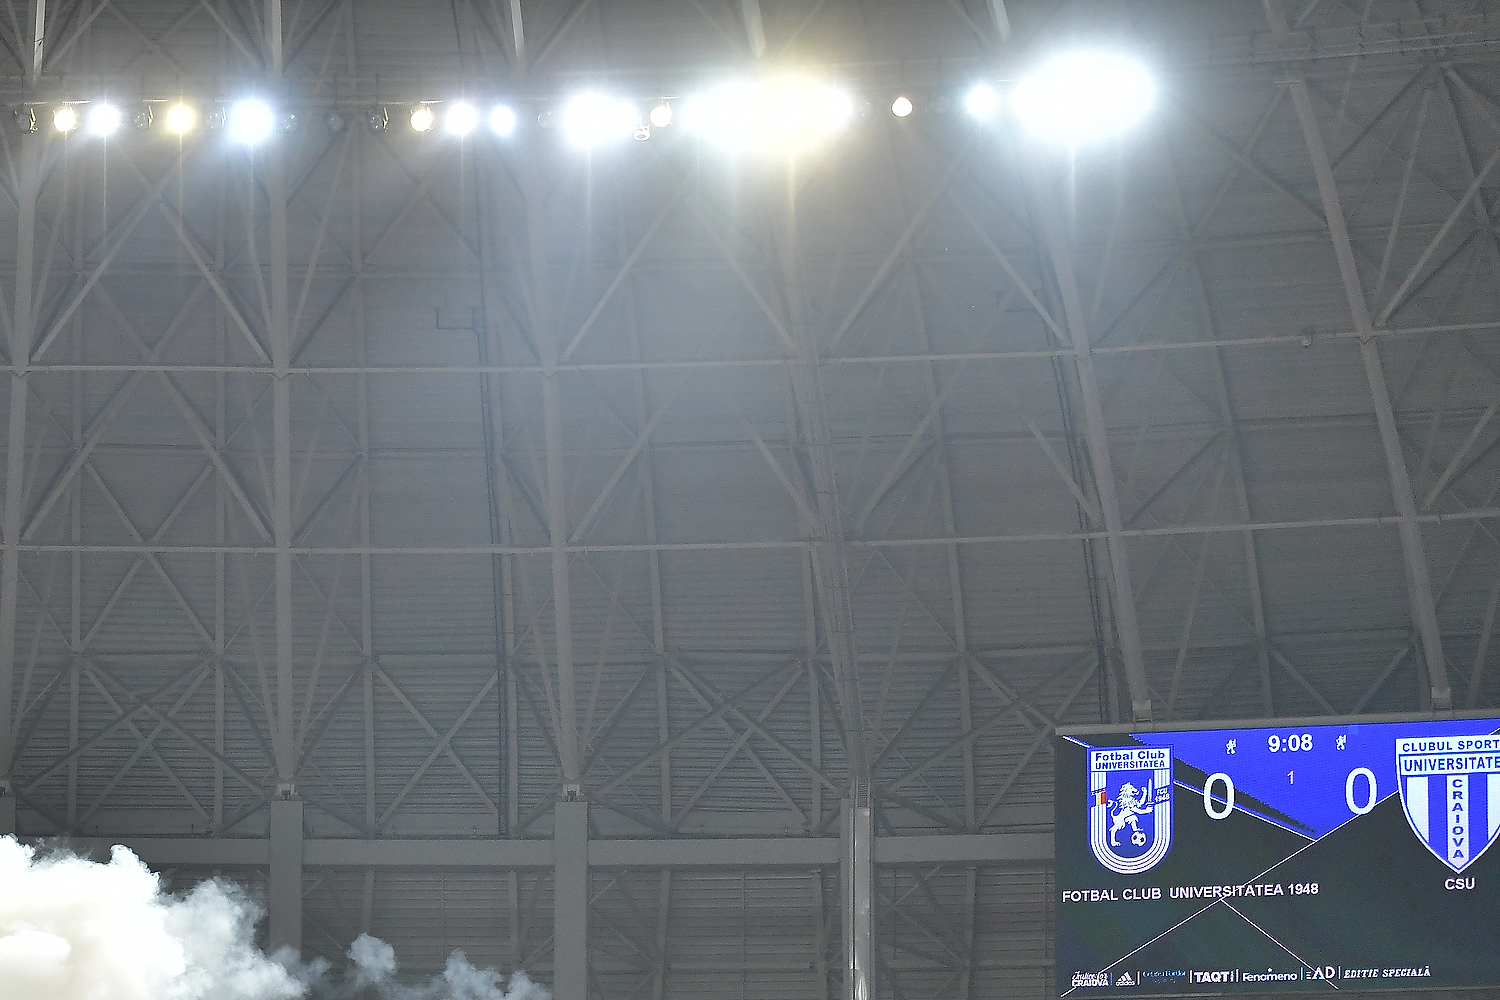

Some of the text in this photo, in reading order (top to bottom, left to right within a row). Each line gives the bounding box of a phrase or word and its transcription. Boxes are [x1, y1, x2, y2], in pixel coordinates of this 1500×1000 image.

[1268, 735, 1313, 753] 9:08
[1402, 741, 1453, 752] CLUBUL
[1095, 750, 1165, 761] Fotbal Club
[1095, 760, 1165, 770] UNIVERSITATEA
[1287, 771, 1294, 784] 1
[1203, 772, 1235, 820] 0
[1346, 767, 1377, 815] 0
[1452, 779, 1464, 859] CRAIOVA
[1444, 878, 1475, 890] CSU
[1062, 883, 1319, 902] FOTBAL CLUB UNIVERSITATEA 1948
